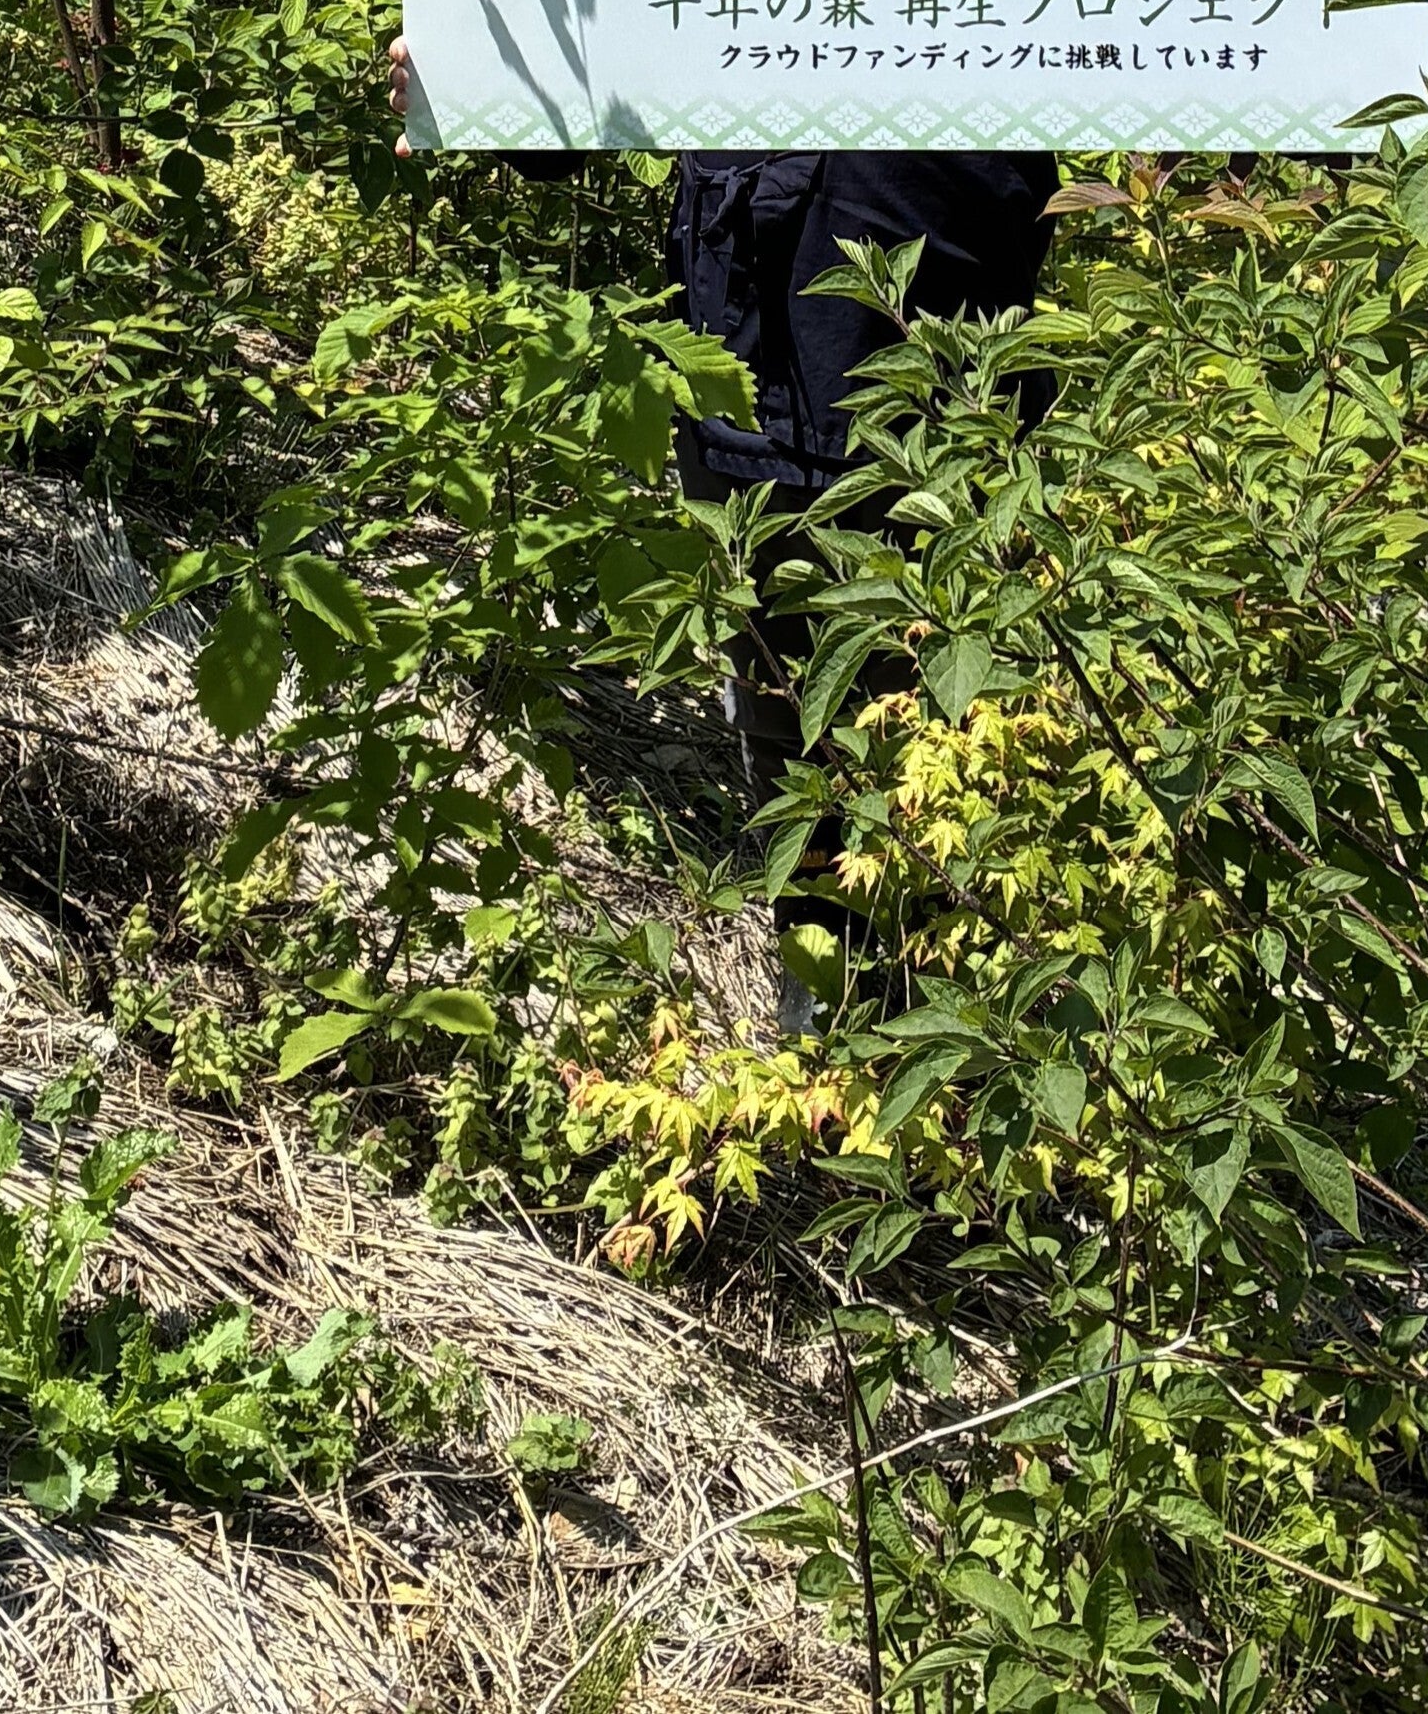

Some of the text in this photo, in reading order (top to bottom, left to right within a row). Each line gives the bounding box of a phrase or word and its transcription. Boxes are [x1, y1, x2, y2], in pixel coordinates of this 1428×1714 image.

[721, 42, 1268, 70] クラウドファンディングに挑戦しています
